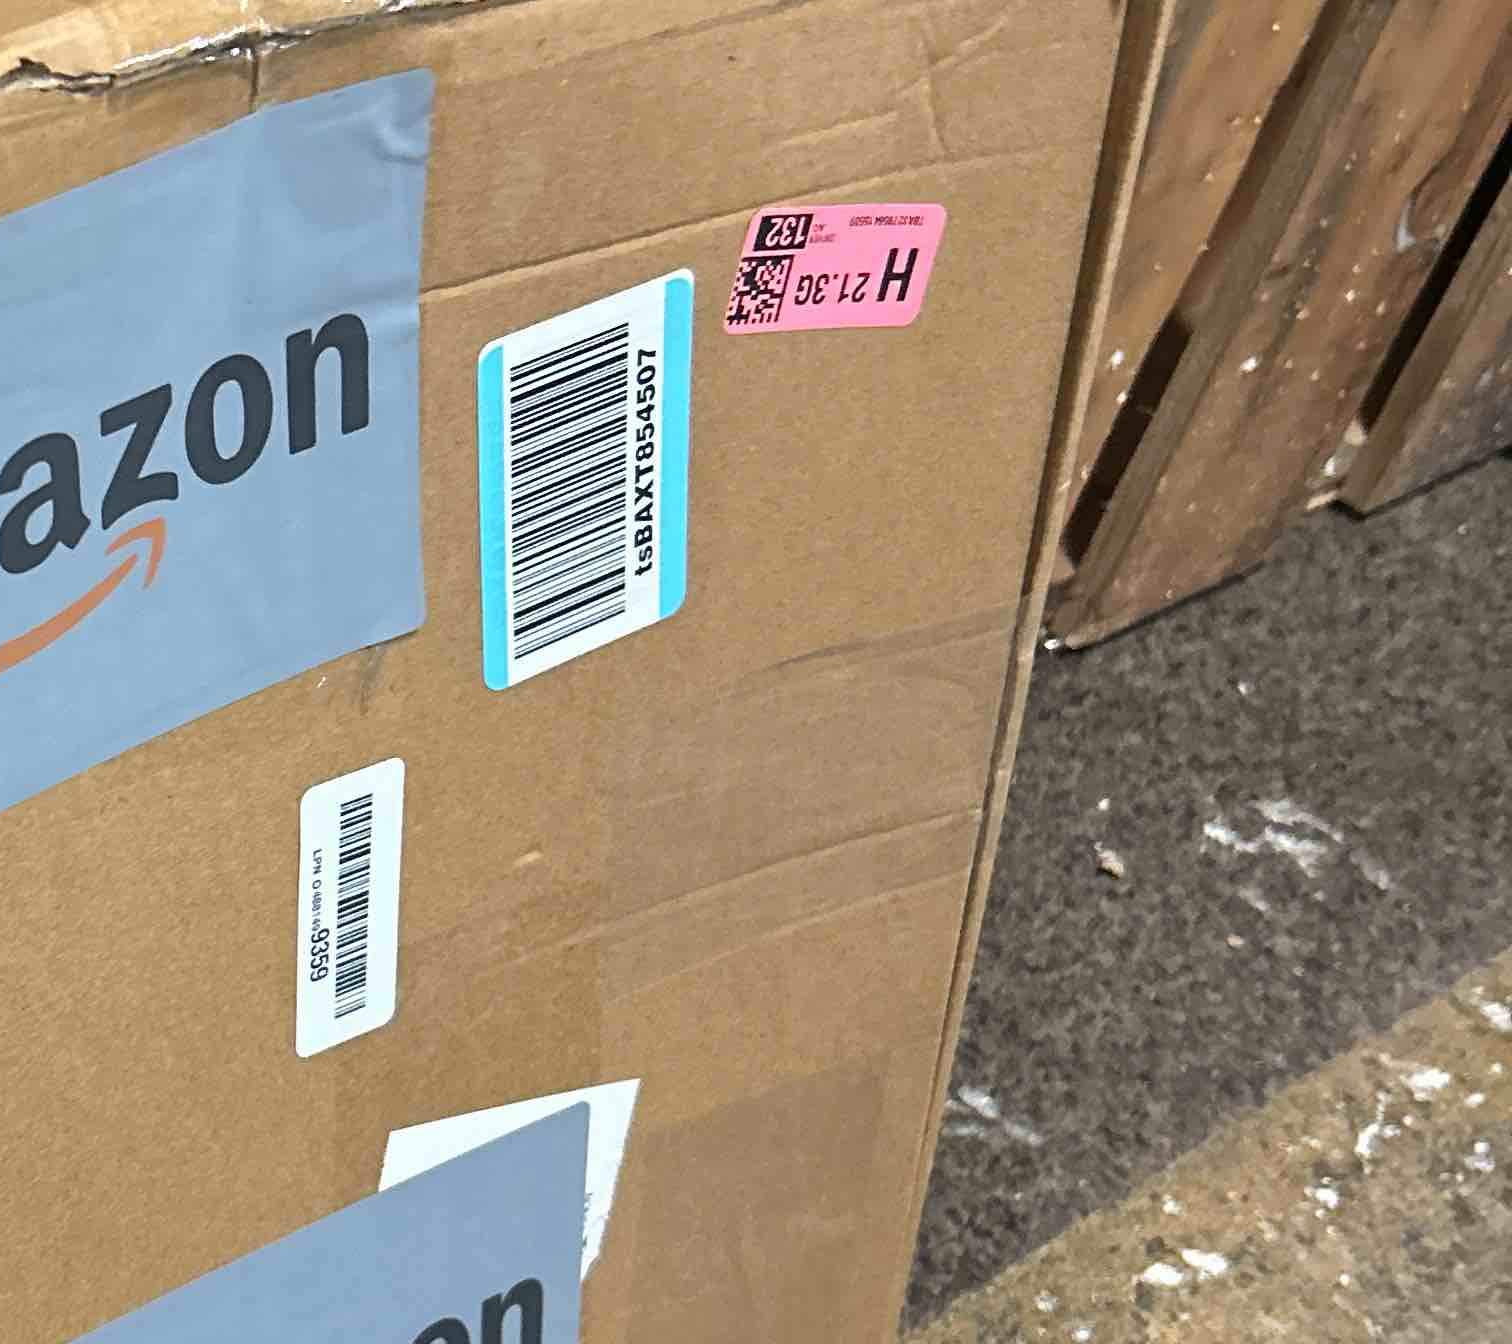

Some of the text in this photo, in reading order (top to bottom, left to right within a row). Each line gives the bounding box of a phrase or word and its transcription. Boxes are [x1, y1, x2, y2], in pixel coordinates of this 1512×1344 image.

[765, 216, 809, 248] 132
[794, 248, 919, 306] H 21.3G
[634, 348, 657, 577] tsBAXT854507
